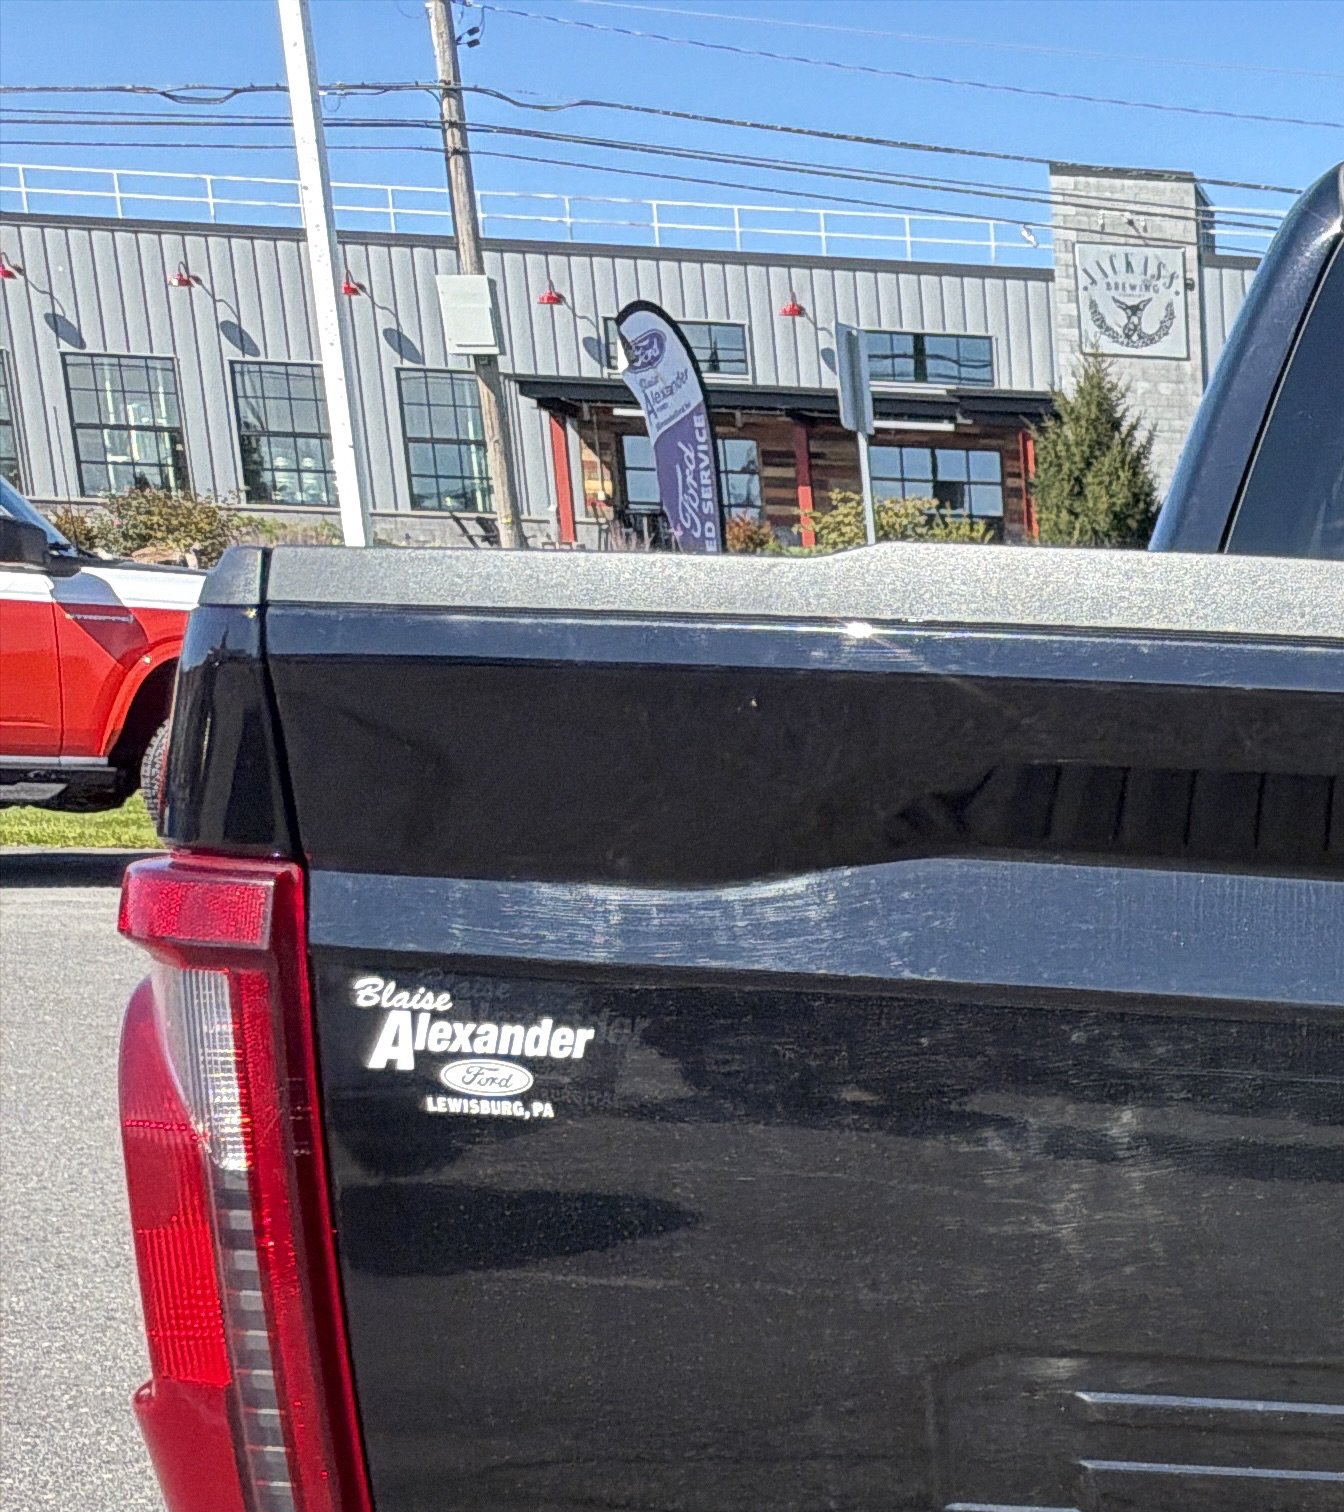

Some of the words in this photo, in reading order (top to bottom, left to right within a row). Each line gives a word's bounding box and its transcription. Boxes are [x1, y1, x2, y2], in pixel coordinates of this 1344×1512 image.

[1105, 280, 1160, 294] BREWING
[692, 414, 715, 515] SERVICE
[676, 440, 702, 539] Ford
[352, 976, 454, 1012] Blaise
[365, 1009, 596, 1071] Alexander
[461, 1065, 514, 1089] Ford
[425, 1096, 531, 1121] LEWISBURG,
[532, 1101, 555, 1119] PA
